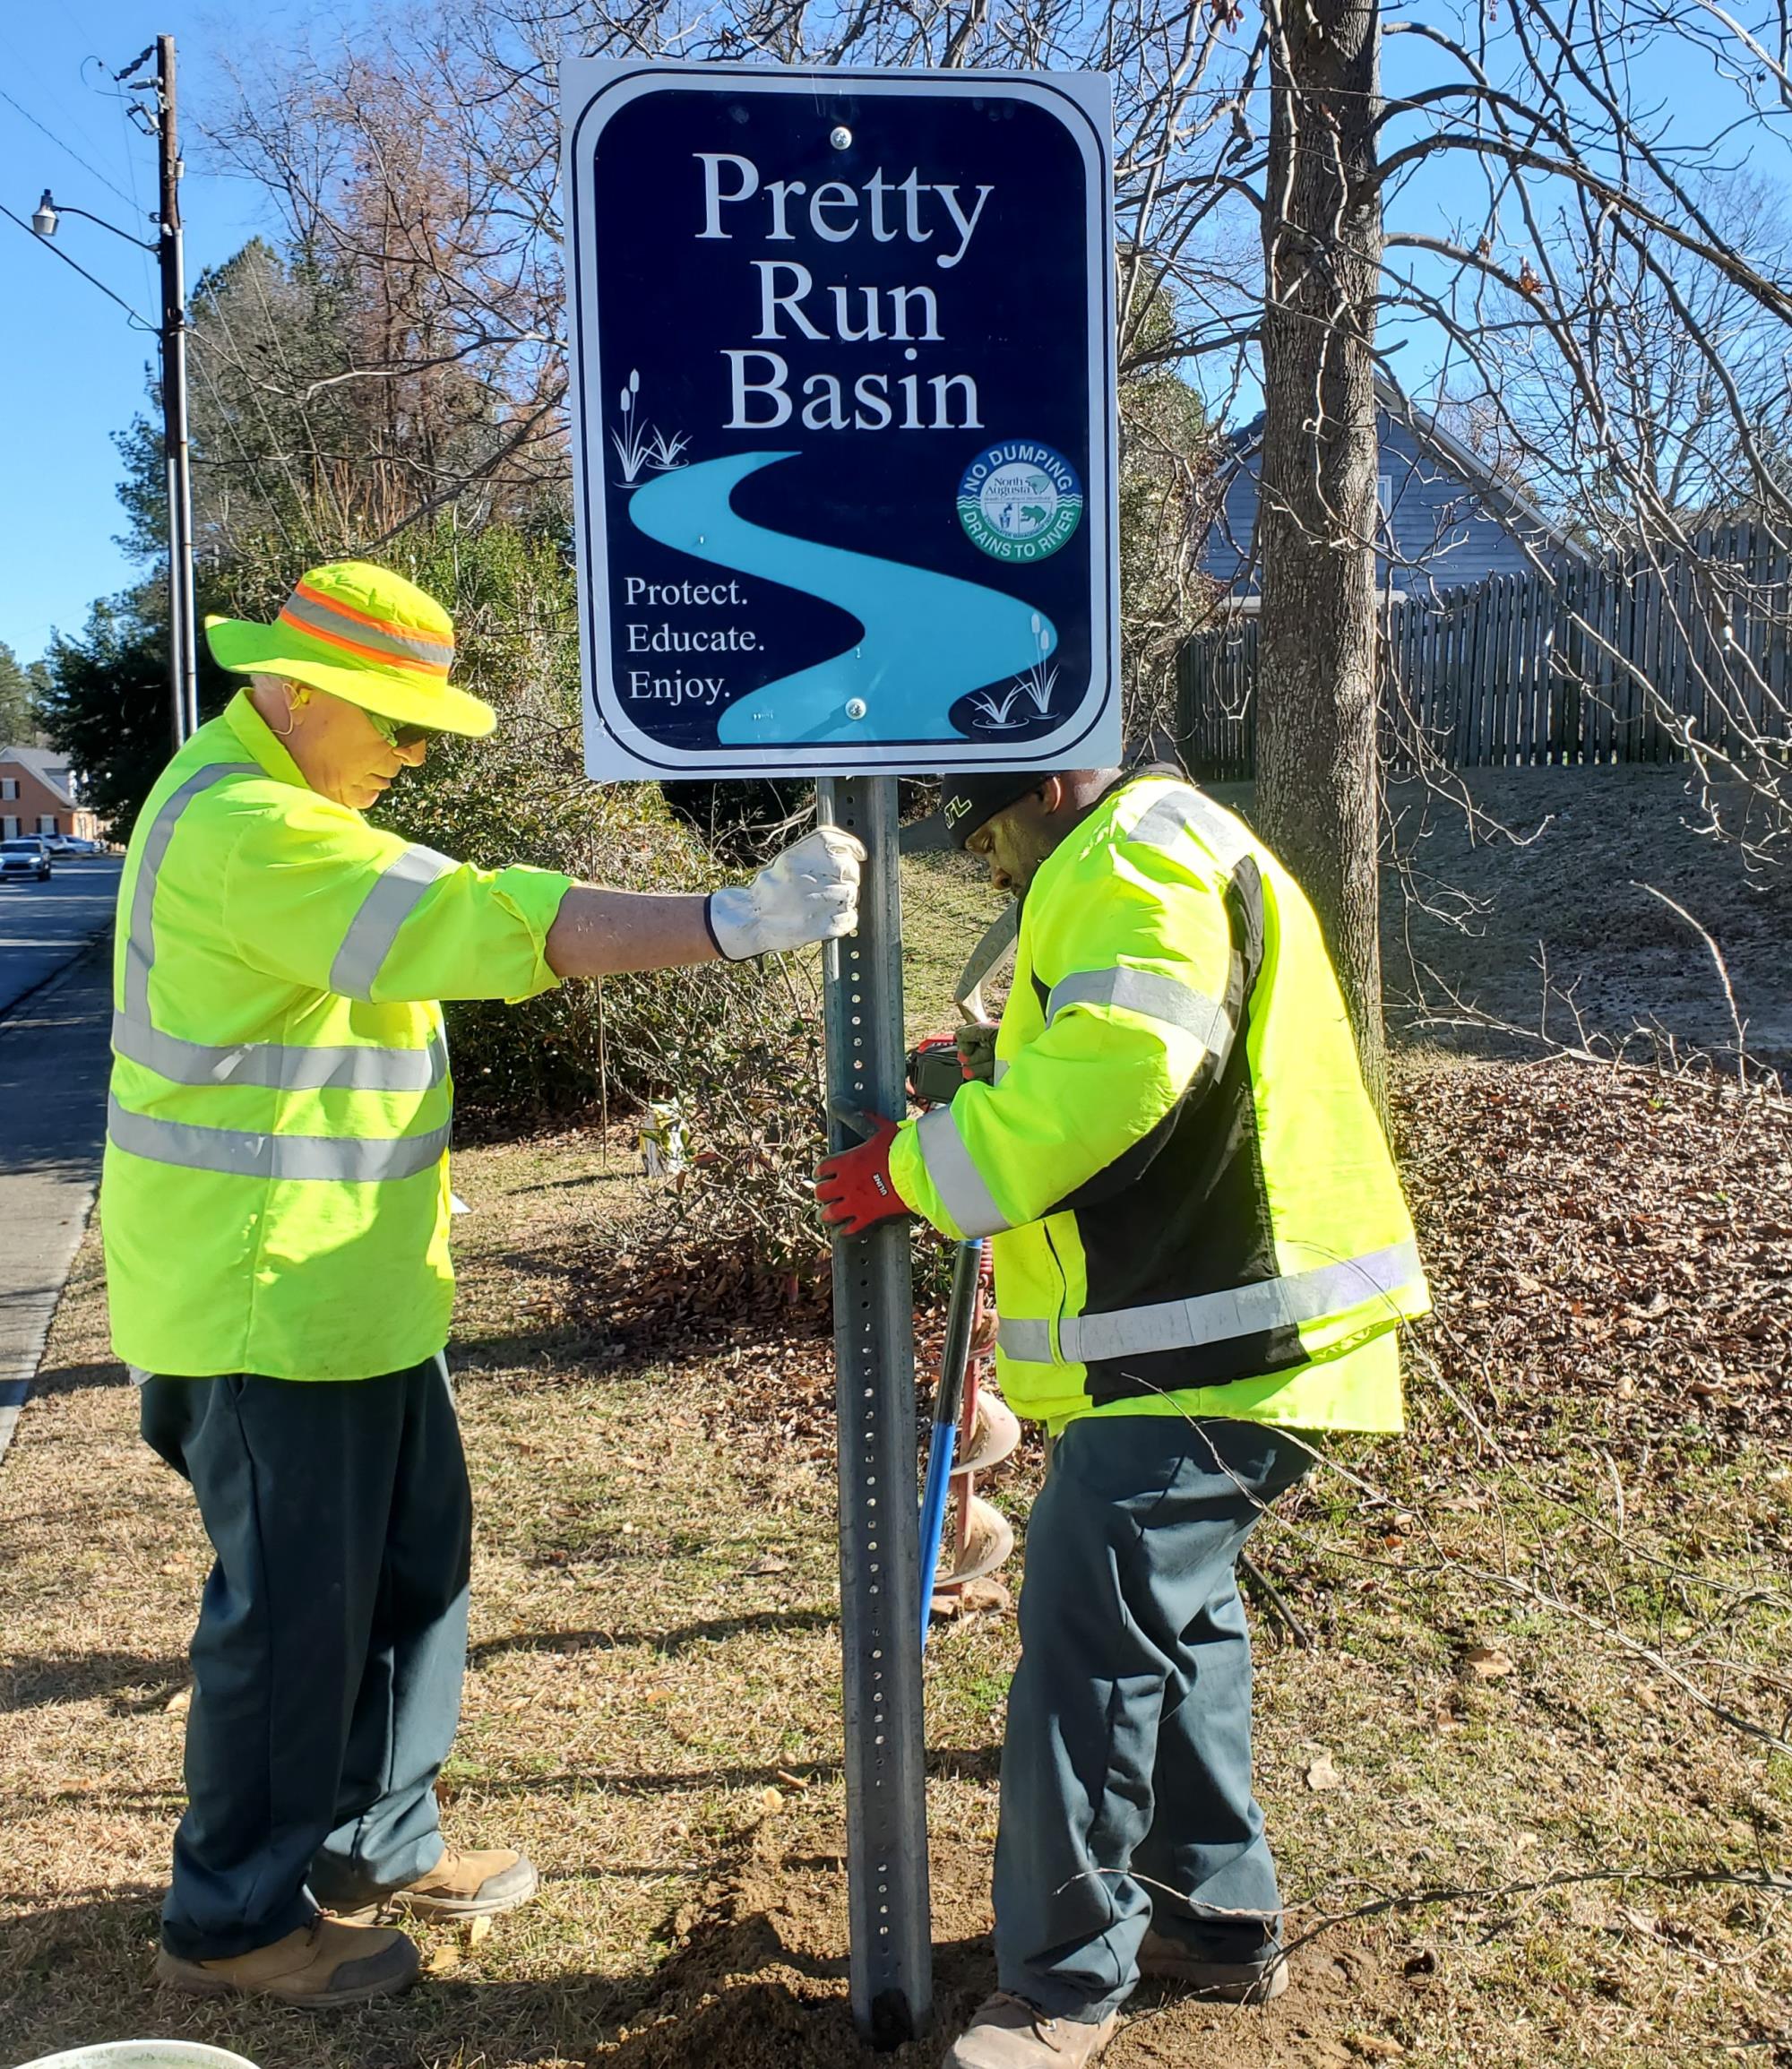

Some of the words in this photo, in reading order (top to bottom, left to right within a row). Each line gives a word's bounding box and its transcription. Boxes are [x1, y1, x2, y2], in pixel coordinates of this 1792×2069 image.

[693, 153, 995, 268] Pretty
[750, 261, 945, 341] Run
[719, 347, 985, 430] Basin
[964, 463, 987, 492] NO
[988, 444, 1073, 491] DUMPING
[993, 477, 1023, 487] North
[986, 486, 1030, 496] Augusta
[963, 512, 1011, 556] DRAINS
[1014, 545, 1036, 557] TO
[1038, 510, 1074, 552] RIVER
[624, 577, 748, 605] Protect.
[625, 623, 764, 652] Educate.
[628, 669, 730, 706] Enjoy.
[873, 1173, 888, 1196] ULINE
